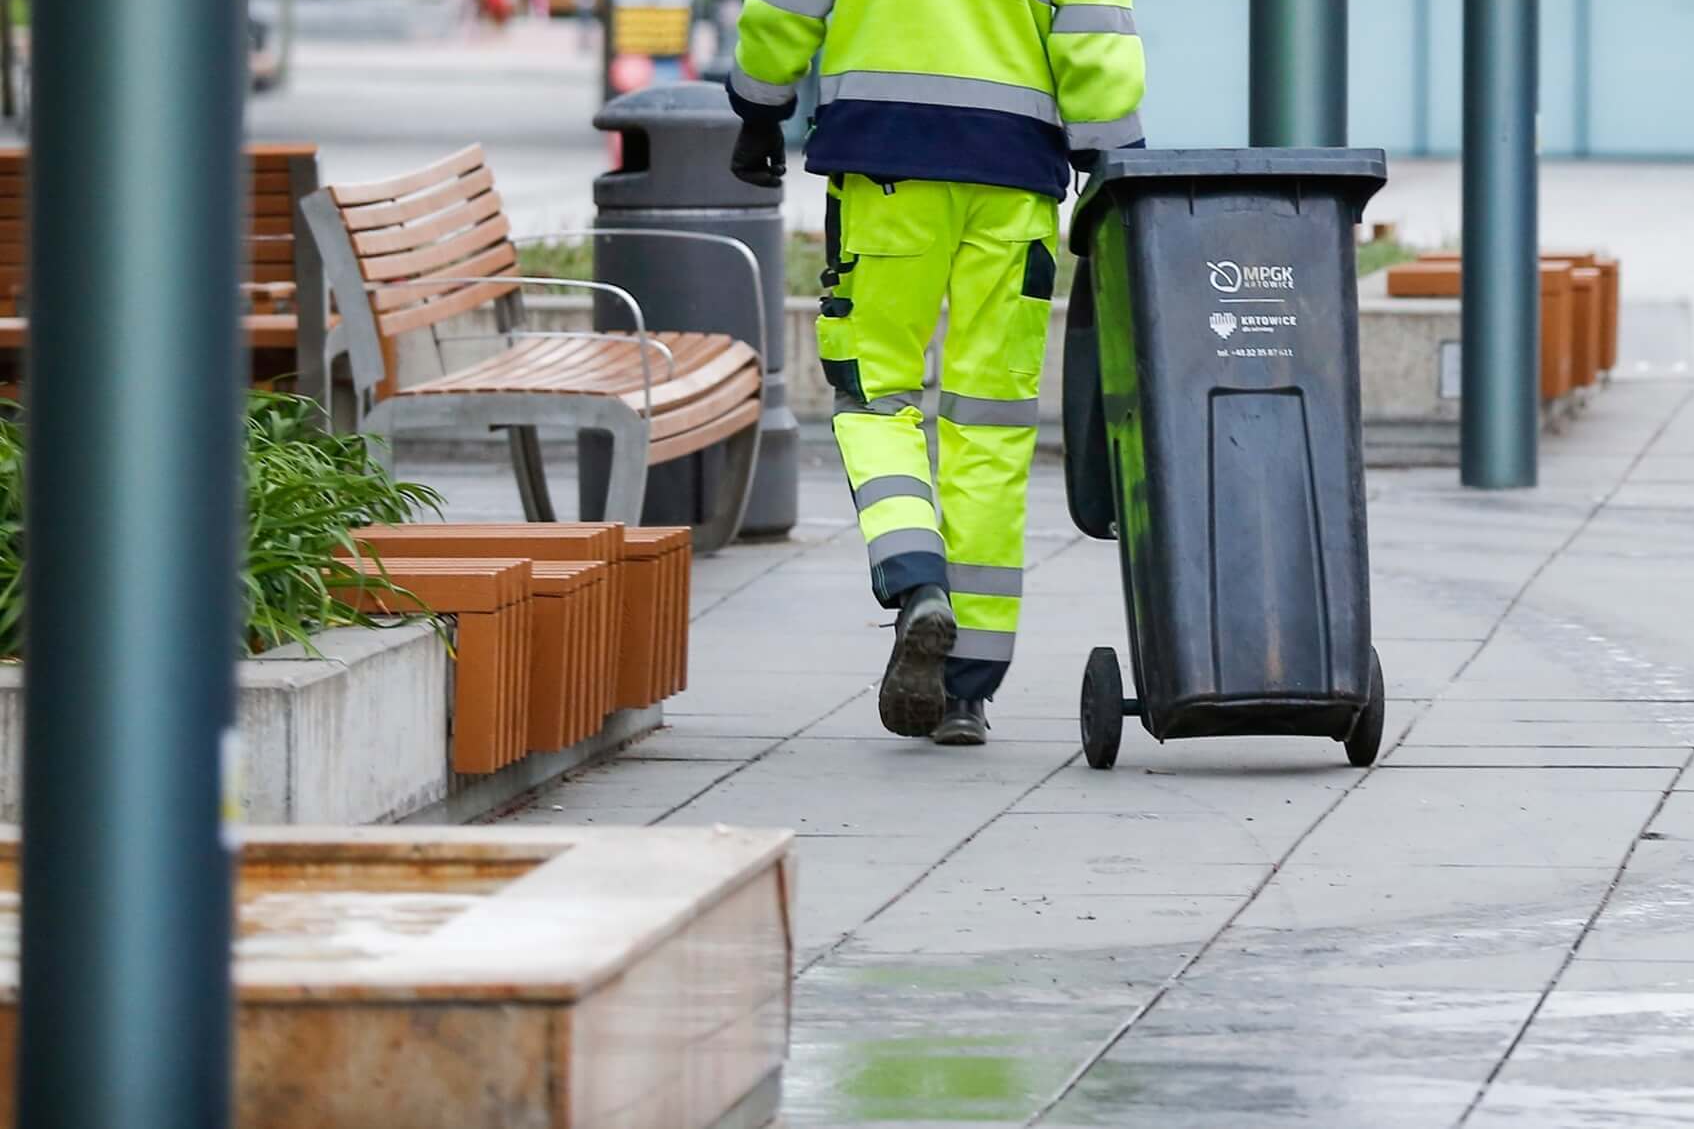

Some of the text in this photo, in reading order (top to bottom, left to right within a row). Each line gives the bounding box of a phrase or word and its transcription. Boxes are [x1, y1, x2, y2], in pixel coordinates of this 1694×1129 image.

[1242, 266, 1294, 281] MPGK
[1243, 280, 1295, 289] KATOWICE
[1240, 316, 1297, 326] KATOWICE
